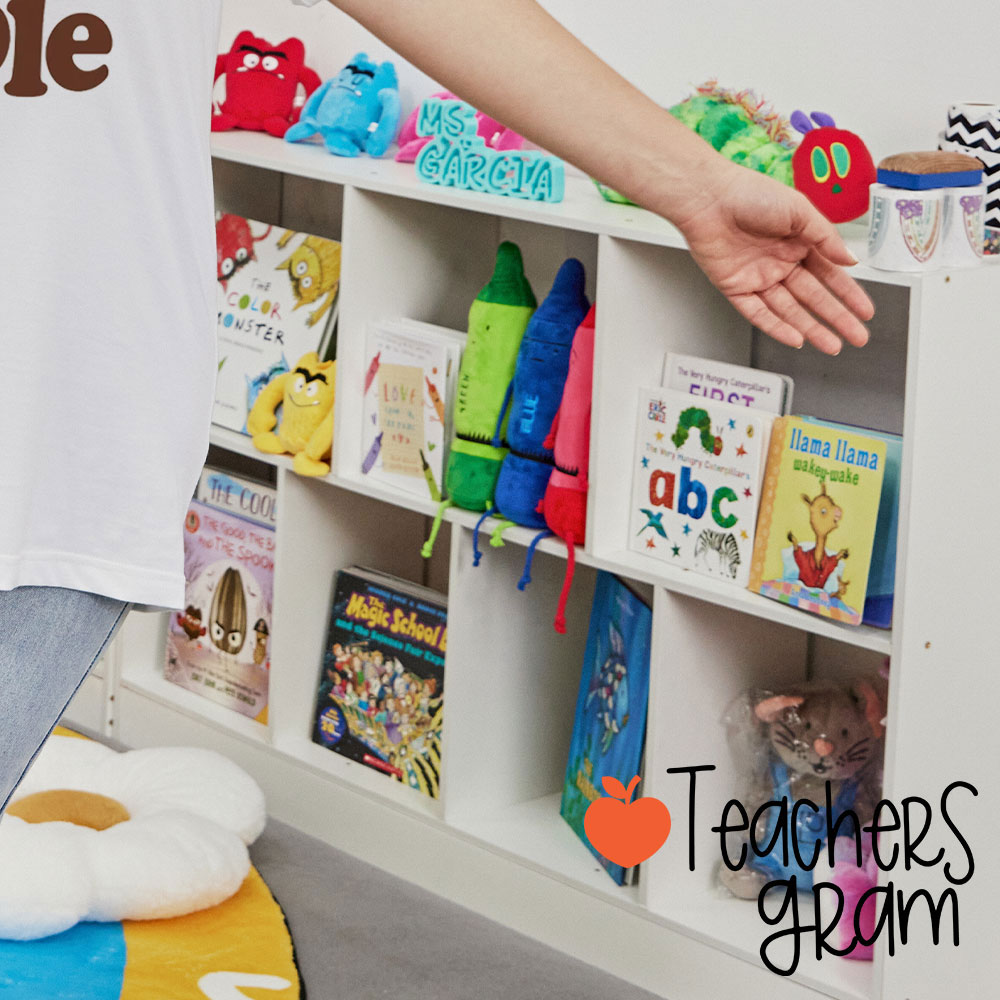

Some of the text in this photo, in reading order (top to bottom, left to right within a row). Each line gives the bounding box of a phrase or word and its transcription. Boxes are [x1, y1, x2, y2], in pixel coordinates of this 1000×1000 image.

[416, 146, 556, 201] GARCIA
[227, 291, 282, 320] COLOR
[678, 366, 688, 377] The
[690, 369, 704, 381] Very
[706, 373, 729, 386] Hungry
[677, 453, 702, 469] Hungry
[789, 427, 879, 471] llama llama
[793, 458, 860, 487] wakey-wake
[649, 467, 739, 529] abc
[346, 592, 391, 628] Magic
[390, 607, 442, 647] School
